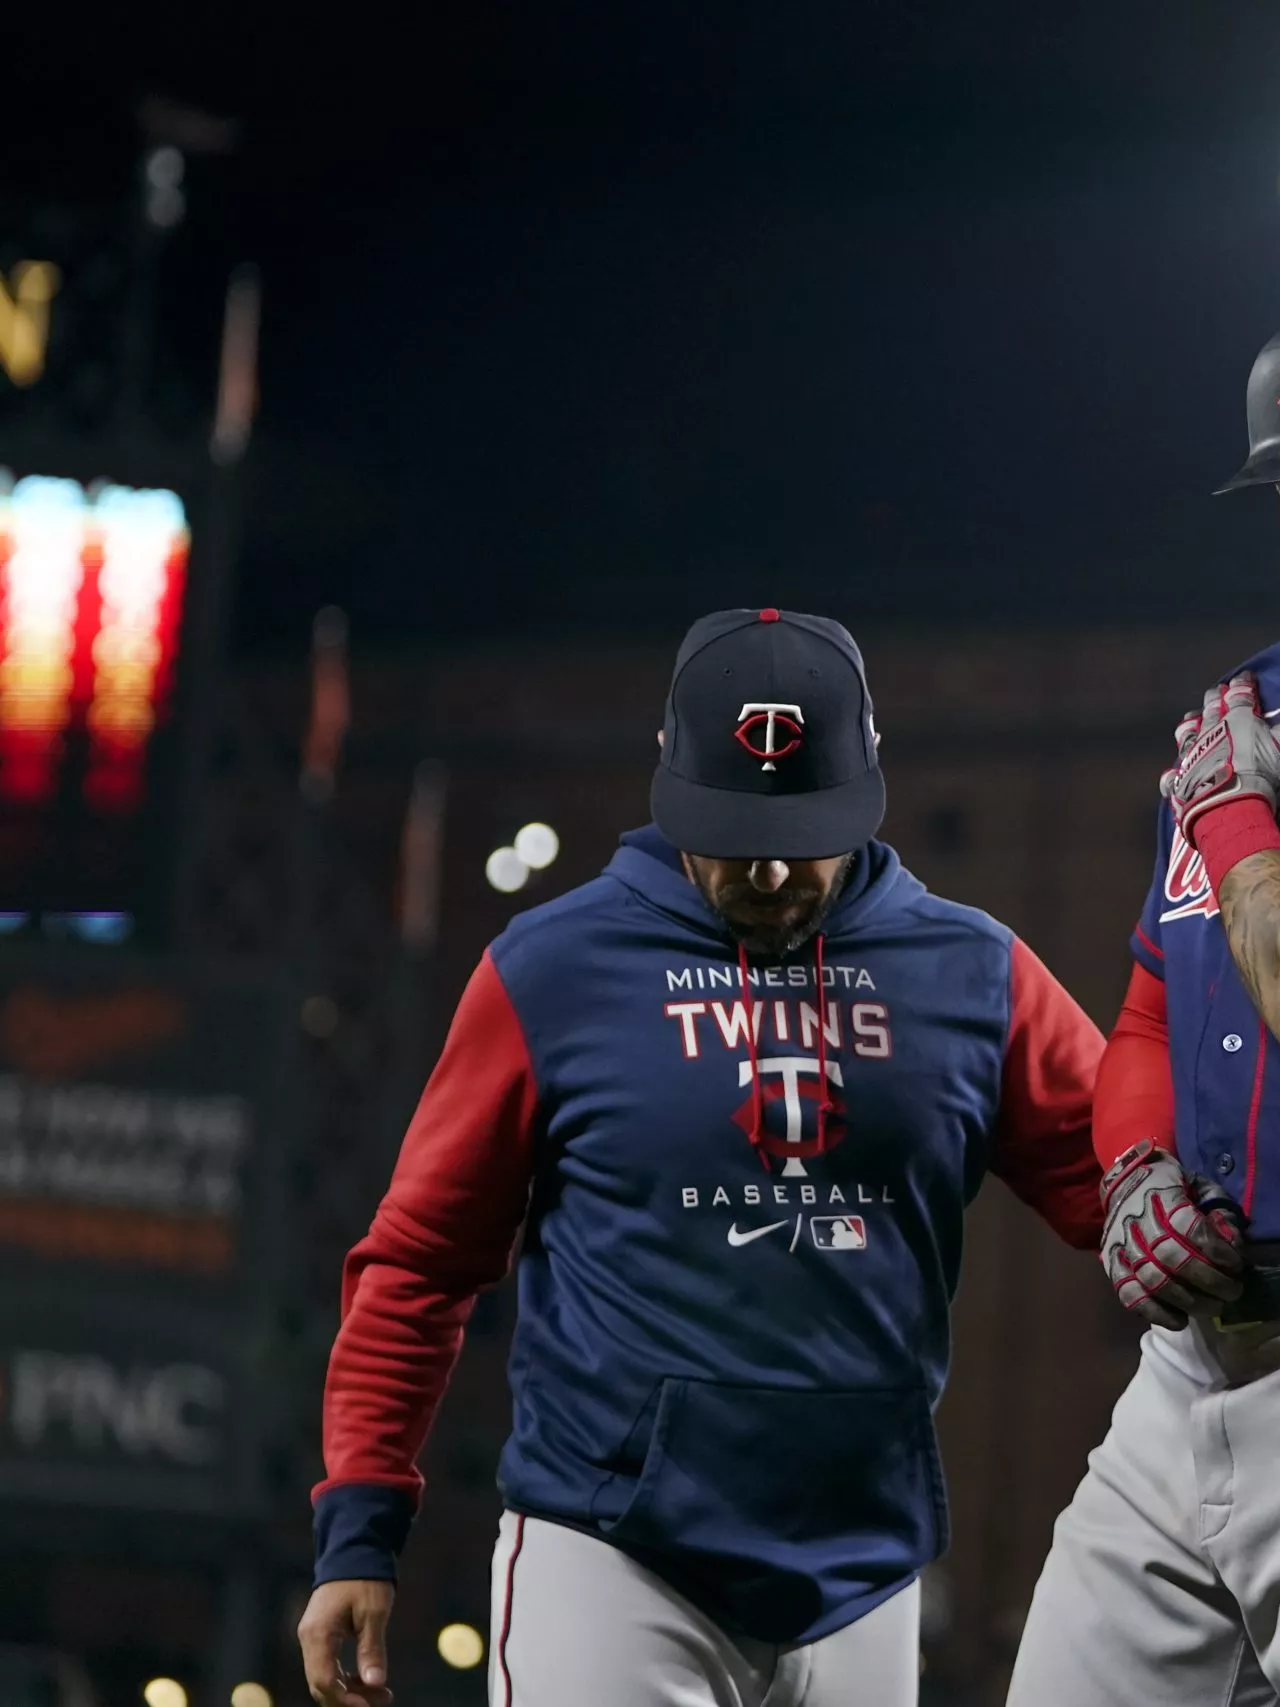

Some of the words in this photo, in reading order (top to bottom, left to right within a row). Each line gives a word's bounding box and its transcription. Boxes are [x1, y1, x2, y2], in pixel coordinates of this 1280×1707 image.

[665, 965, 876, 992] MINNESOTA
[664, 1000, 893, 1058] TWINS
[682, 1184, 895, 1208] BASEBALL
